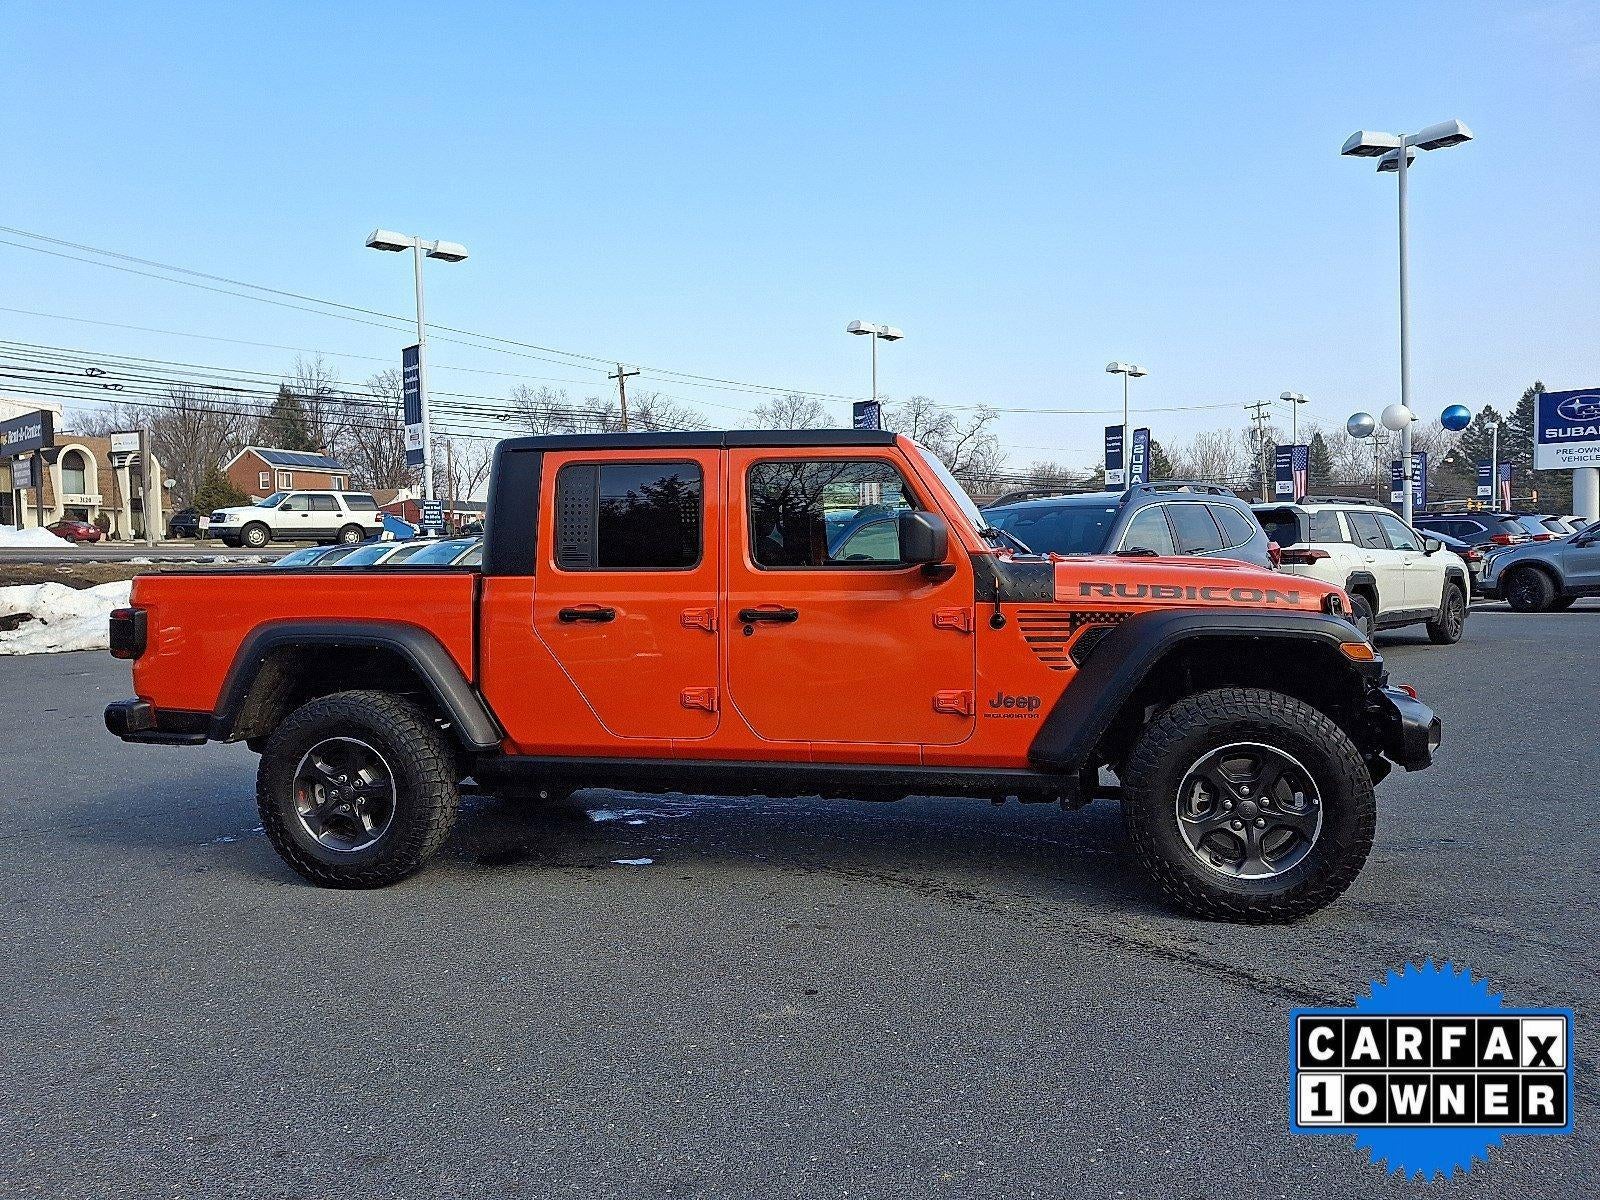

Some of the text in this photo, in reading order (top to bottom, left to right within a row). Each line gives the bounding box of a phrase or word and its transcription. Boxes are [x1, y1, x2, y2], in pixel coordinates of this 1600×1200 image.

[1545, 426, 1600, 438] SUBA
[1079, 582, 1300, 604] RUBICON
[989, 691, 1041, 711] Jeep
